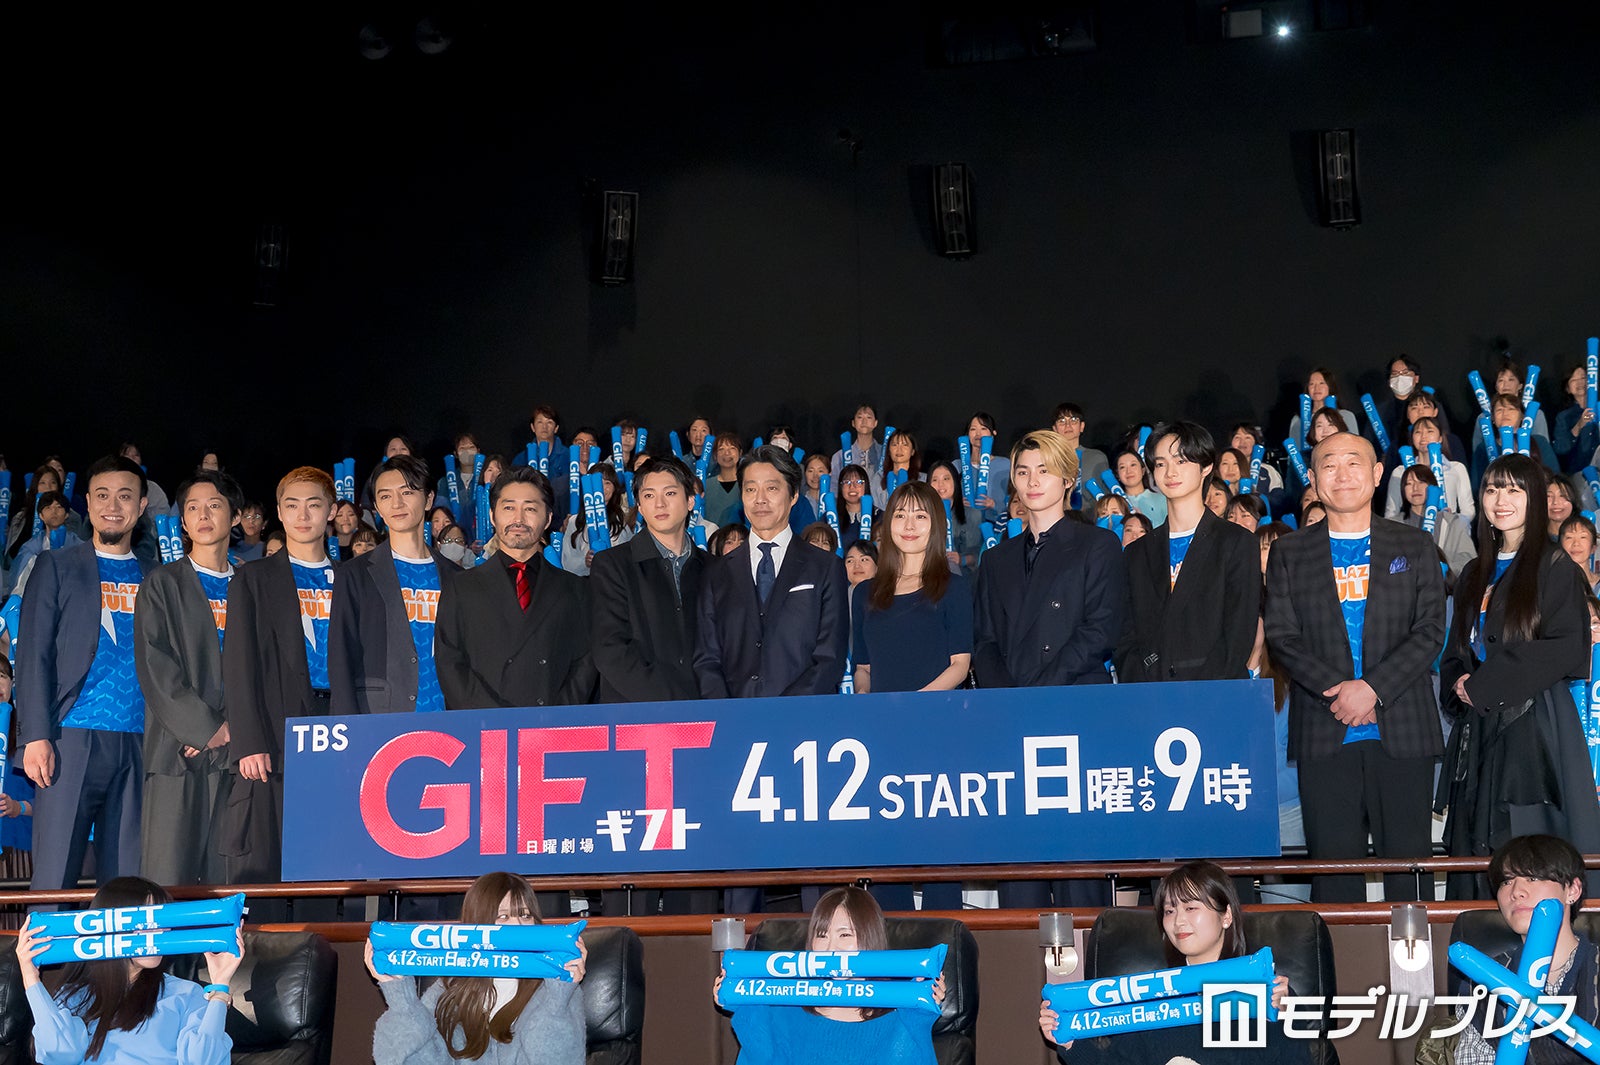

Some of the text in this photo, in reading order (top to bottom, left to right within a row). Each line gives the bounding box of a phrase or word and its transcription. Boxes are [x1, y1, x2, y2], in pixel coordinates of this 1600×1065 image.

[1587, 354, 1599, 392] GIFT
[612, 442, 625, 473] GIFT
[978, 453, 991, 487] GIFT
[344, 475, 354, 503] GIF
[447, 471, 460, 503] GIFT
[569, 461, 580, 496] GIFT
[583, 493, 598, 531] GIFT
[593, 491, 609, 530] GIFT
[860, 514, 872, 540] GIF
[159, 535, 172, 564] GIF
[292, 723, 349, 753] TBS
[359, 721, 717, 860] GIFT
[731, 738, 871, 822] 4.12
[878, 771, 1015, 820] START
[526, 808, 701, 855] 日曜劇場 ギフト
[74, 905, 164, 935] GIFT
[73, 931, 164, 960] GIFT
[411, 924, 503, 950] GIFT
[416, 956, 445, 967] START
[492, 954, 520, 969] TBS
[766, 951, 860, 978] GIFT
[734, 979, 766, 996] 4.12
[765, 985, 795, 996] START
[845, 984, 875, 998] TBS
[1088, 968, 1182, 1007] GIFT
[1070, 1011, 1102, 1031] 4.12
[1101, 1014, 1132, 1028] START
[1182, 1001, 1204, 1017] TB
